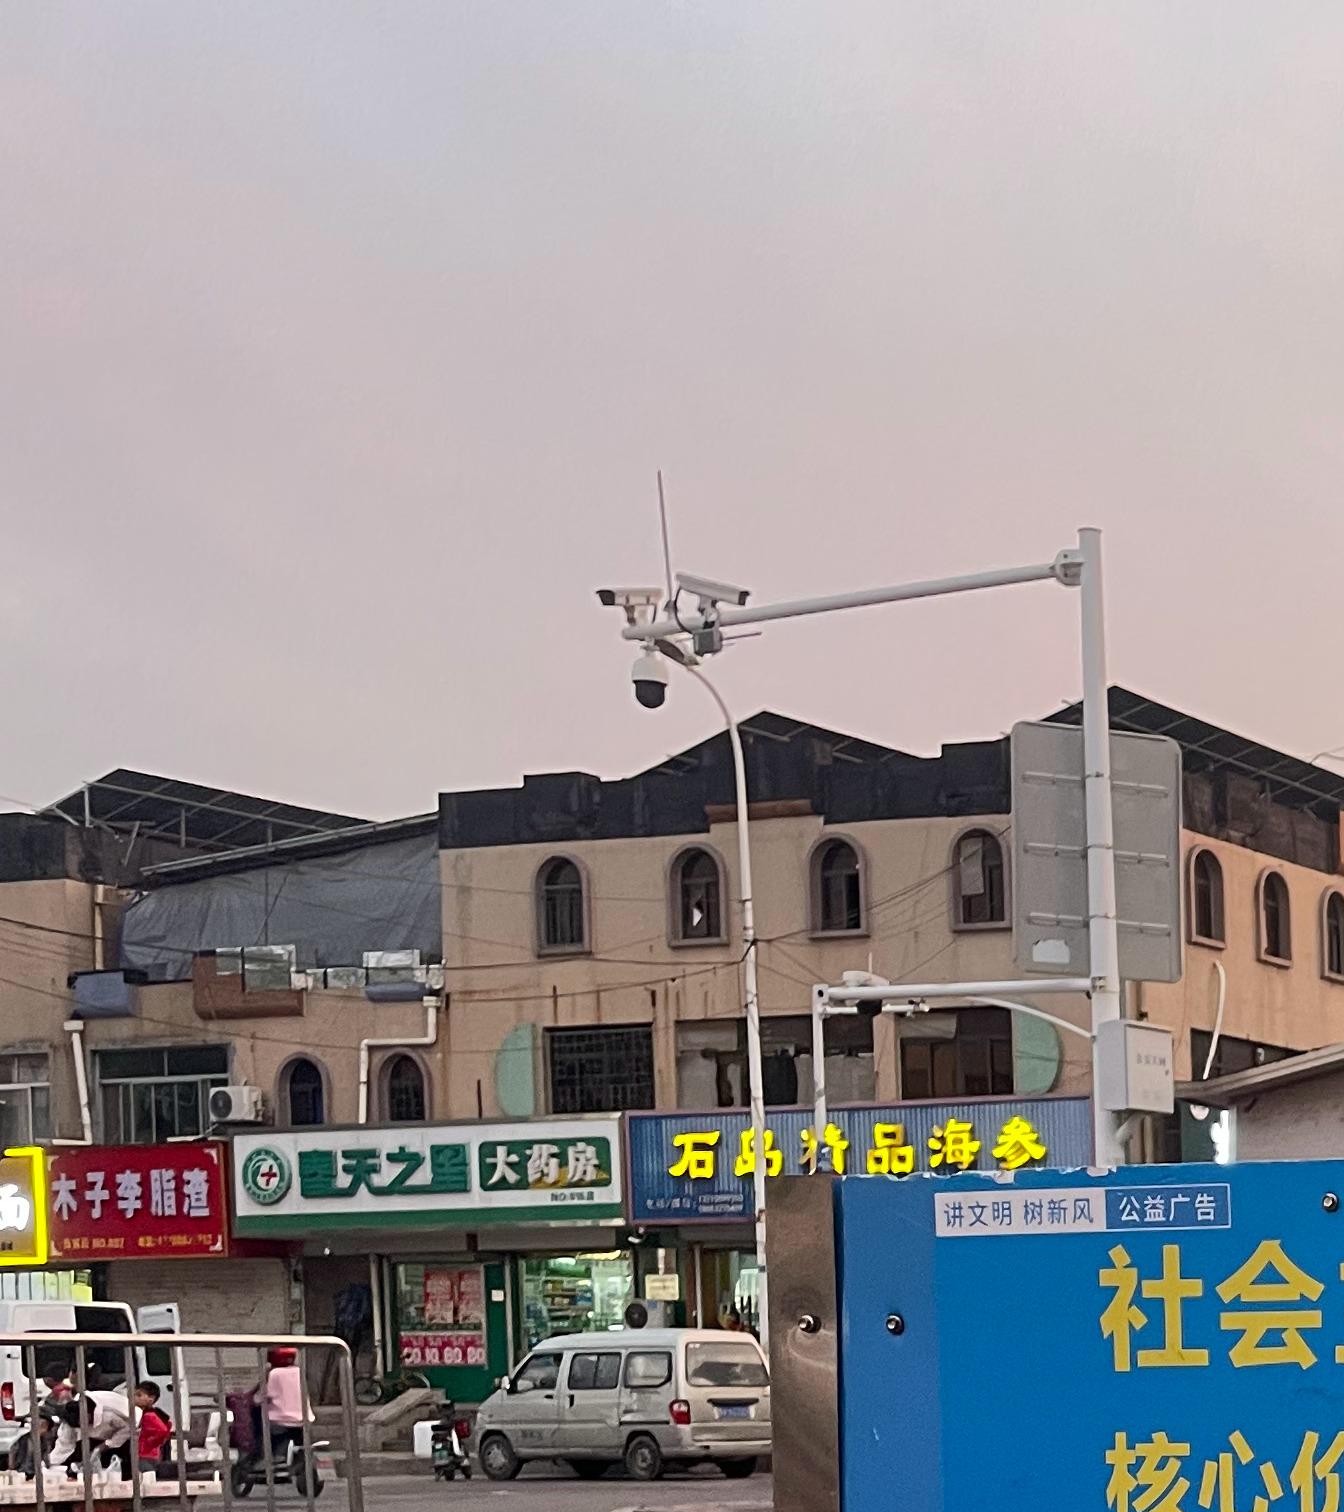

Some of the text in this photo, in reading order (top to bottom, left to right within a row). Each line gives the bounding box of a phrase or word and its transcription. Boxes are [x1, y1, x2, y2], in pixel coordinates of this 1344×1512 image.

[486, 1141, 600, 1186] 大药房
[52, 1168, 210, 1221] 木子李脂渣
[944, 1197, 1094, 1228] 讲文明 树新风
[1118, 1192, 1217, 1222] 公益广告
